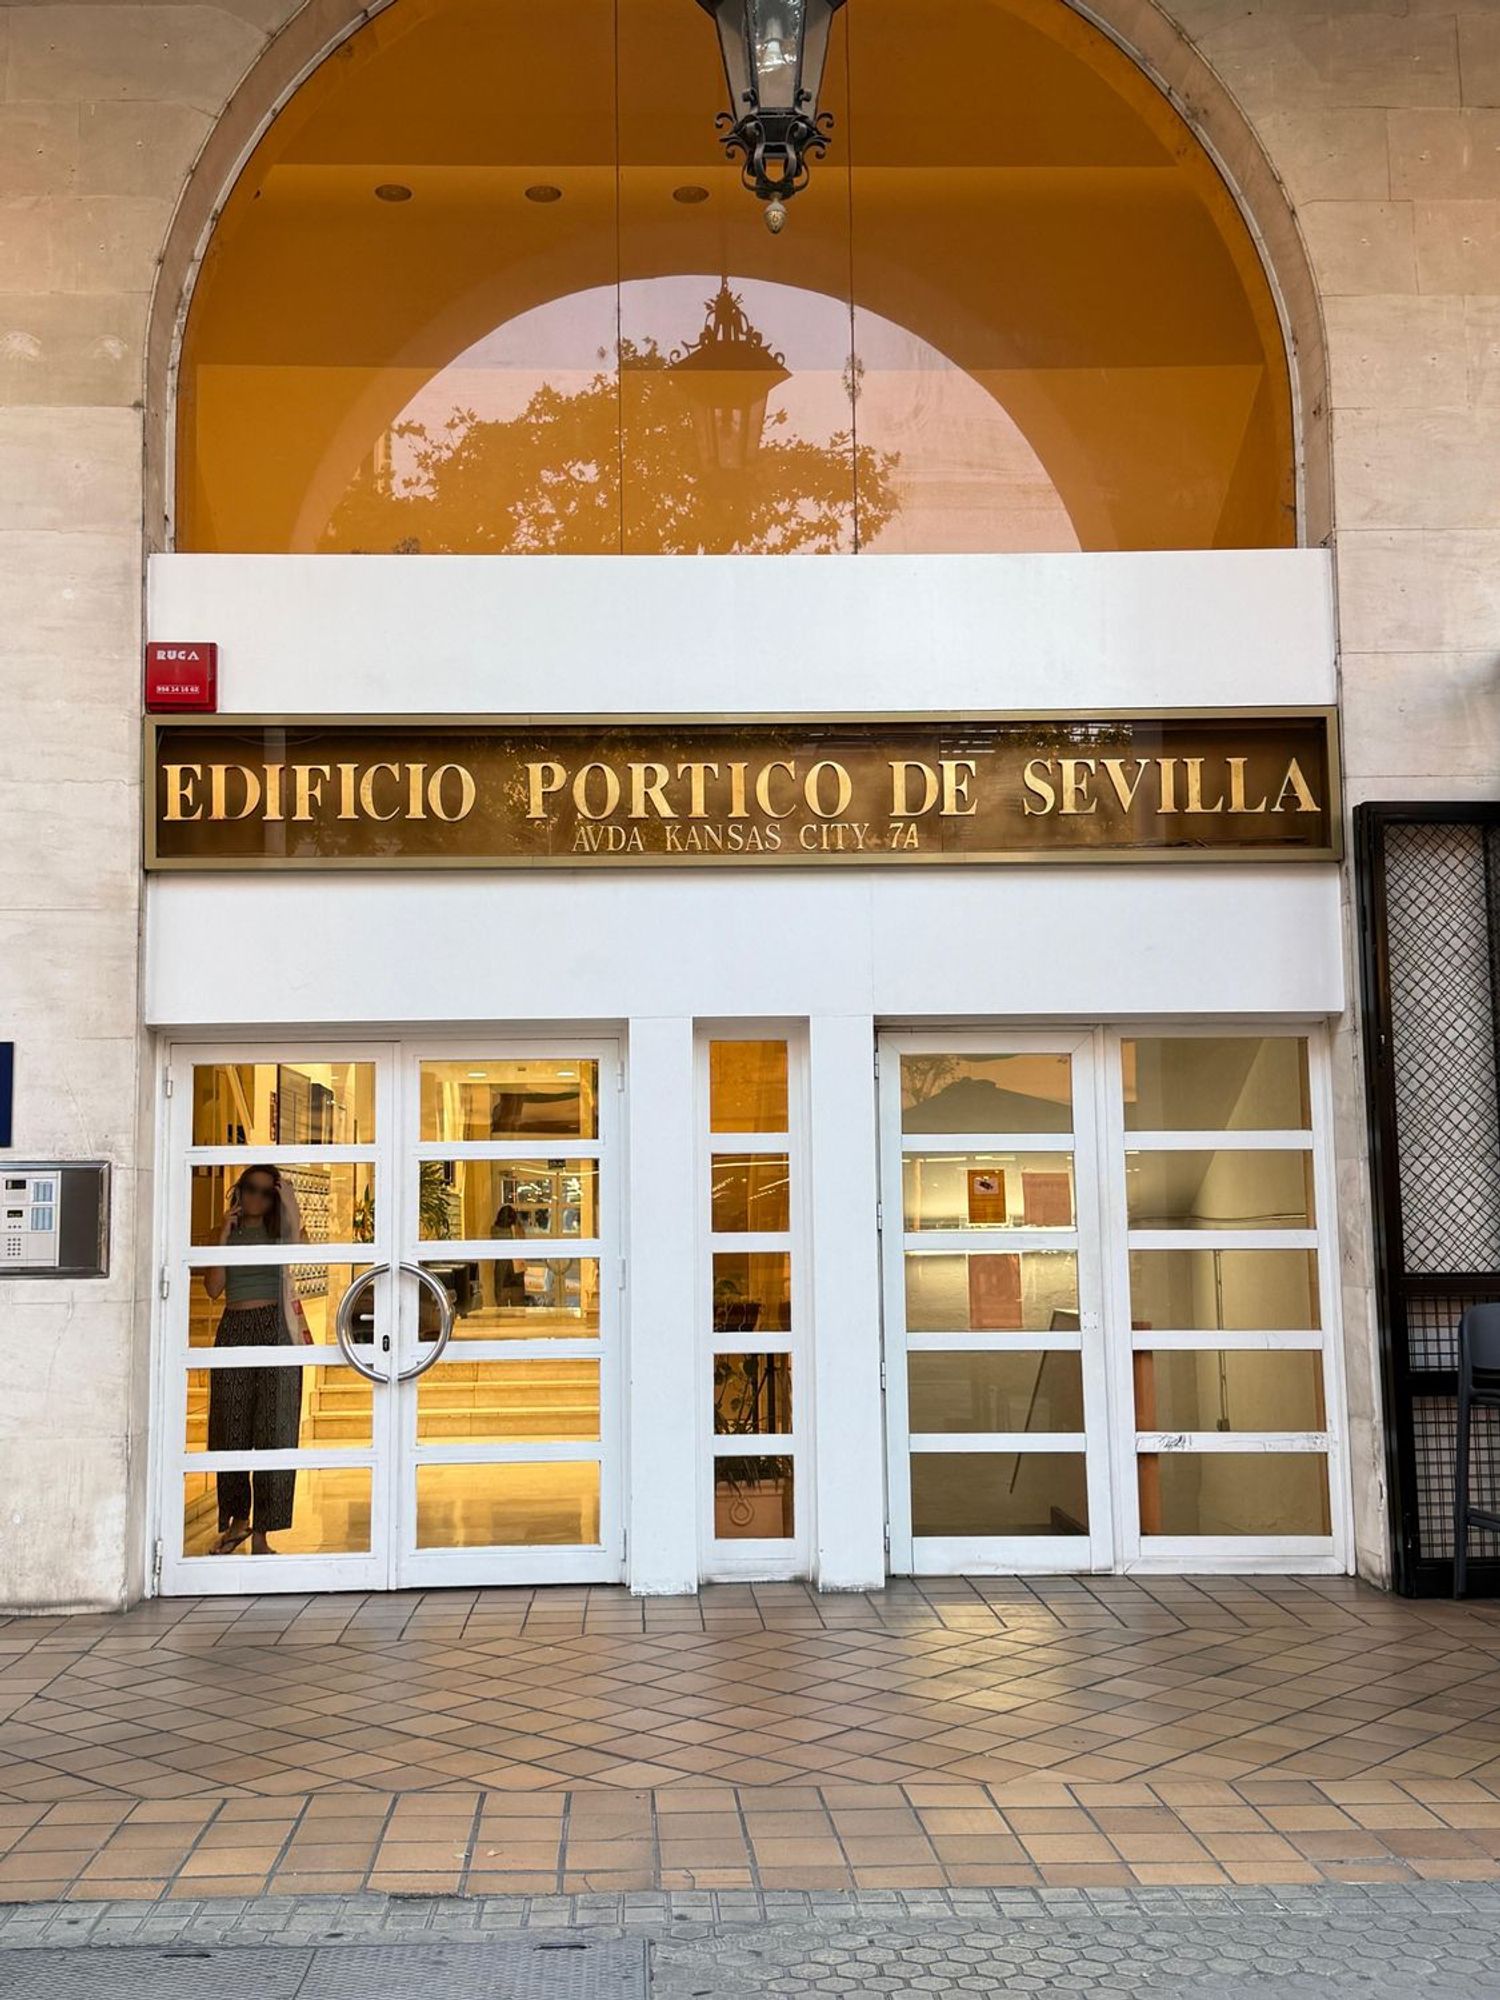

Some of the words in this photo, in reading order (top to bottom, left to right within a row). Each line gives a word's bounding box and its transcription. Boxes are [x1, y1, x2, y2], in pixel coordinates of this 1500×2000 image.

[156, 650, 199, 660] RUCA
[163, 763, 476, 822] EDIFICIO
[526, 760, 852, 819] PORTICO
[889, 759, 978, 817] DE
[1023, 757, 1320, 815] SEVILLA
[572, 824, 645, 852] AVDA
[665, 822, 781, 852] KANSAS
[799, 822, 871, 851] CITY
[889, 822, 920, 850] 7A
